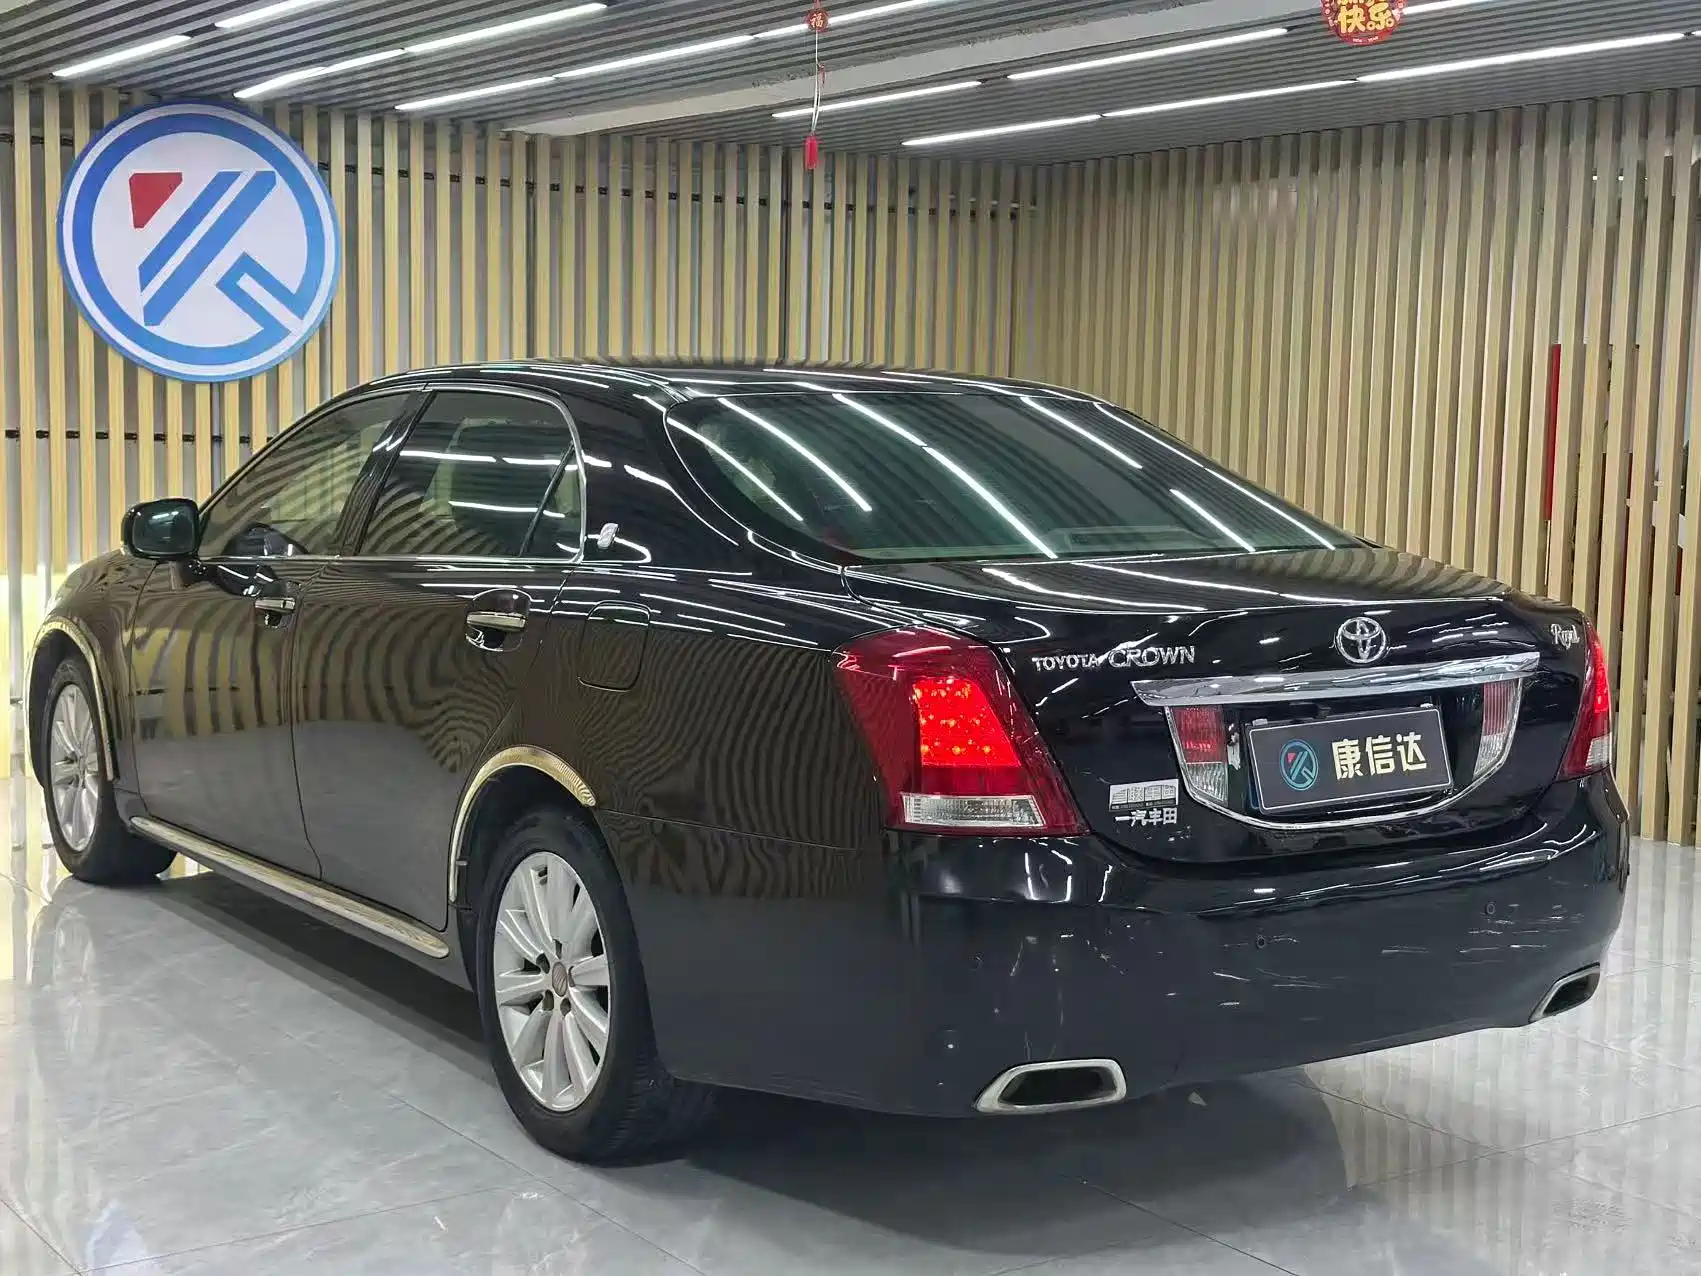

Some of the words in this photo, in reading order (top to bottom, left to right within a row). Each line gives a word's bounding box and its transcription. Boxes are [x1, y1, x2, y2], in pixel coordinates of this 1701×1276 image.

[1337, 2, 1395, 33] 快乐
[1031, 653, 1101, 672] TOYOTA
[1108, 645, 1196, 668] CROWN
[1331, 731, 1427, 780] 康信达
[1115, 807, 1178, 828] 一汽丰田
